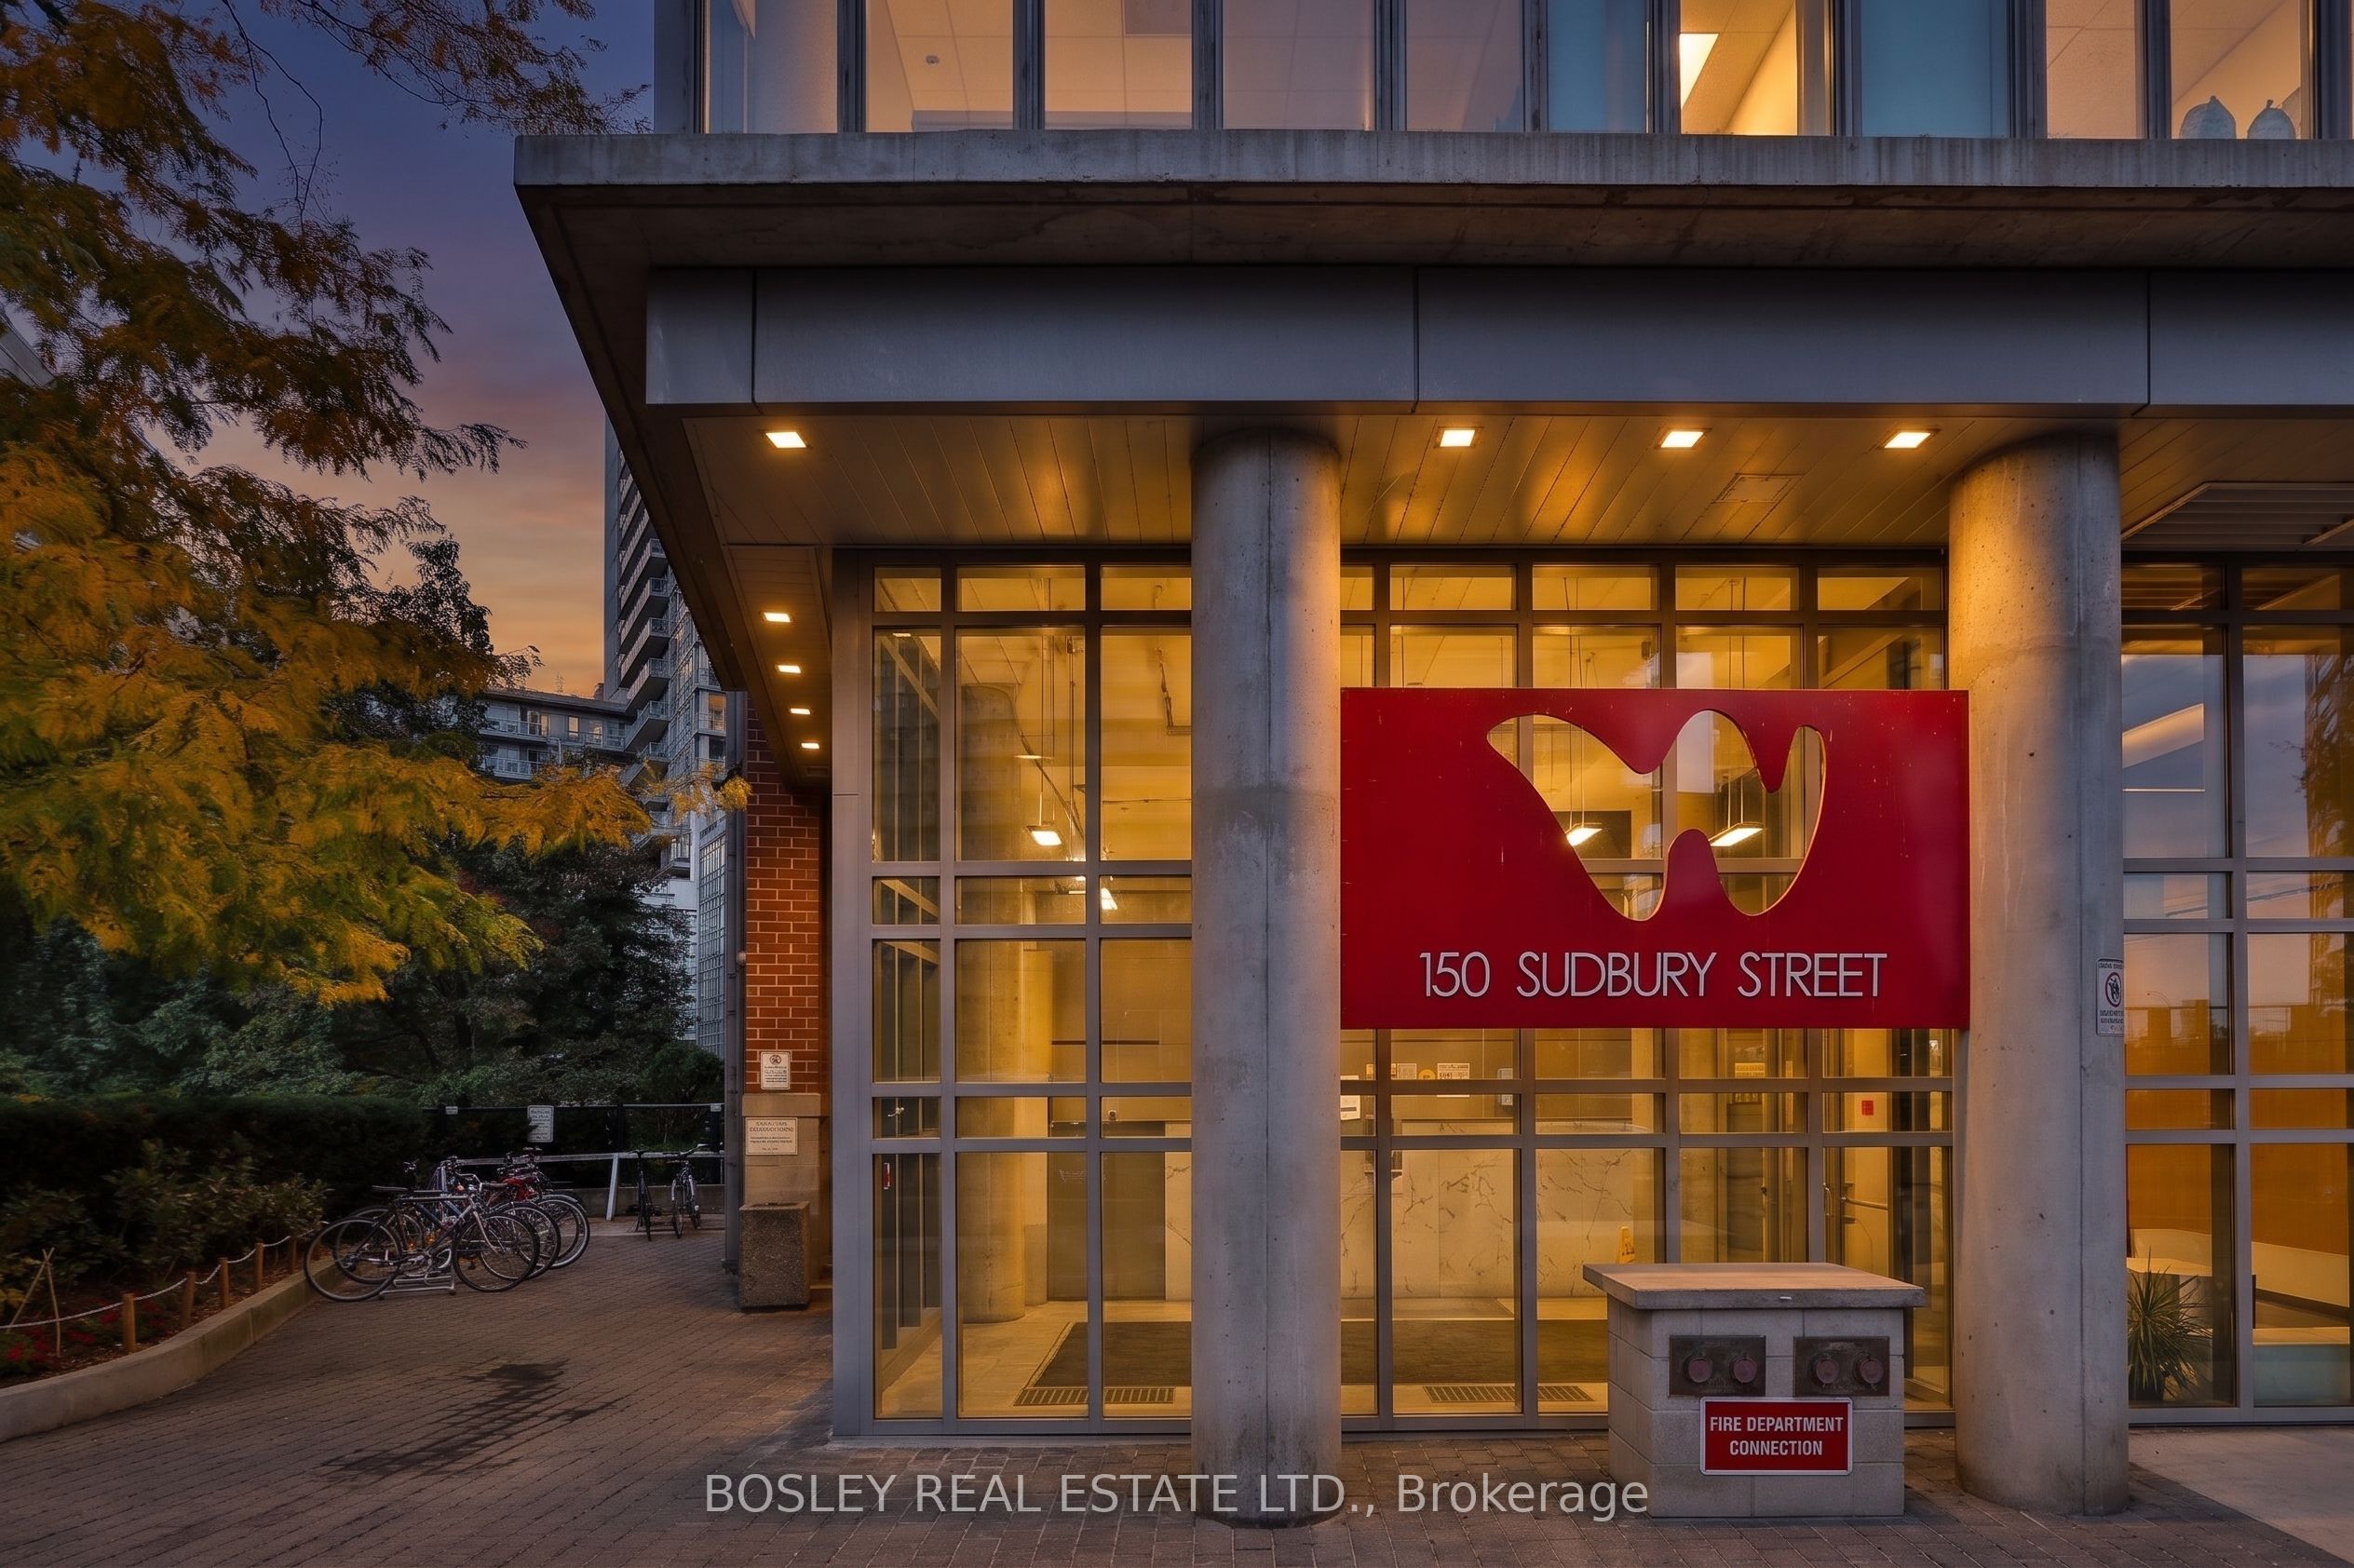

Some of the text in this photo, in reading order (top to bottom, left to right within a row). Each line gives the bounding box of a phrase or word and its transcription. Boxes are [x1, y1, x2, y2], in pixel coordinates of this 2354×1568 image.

[1419, 951, 1887, 997] 150 SUDBURY STREET
[1710, 1416, 1844, 1432] FIRE DEPARTMENT
[1729, 1440, 1823, 1456] CONNECTION
